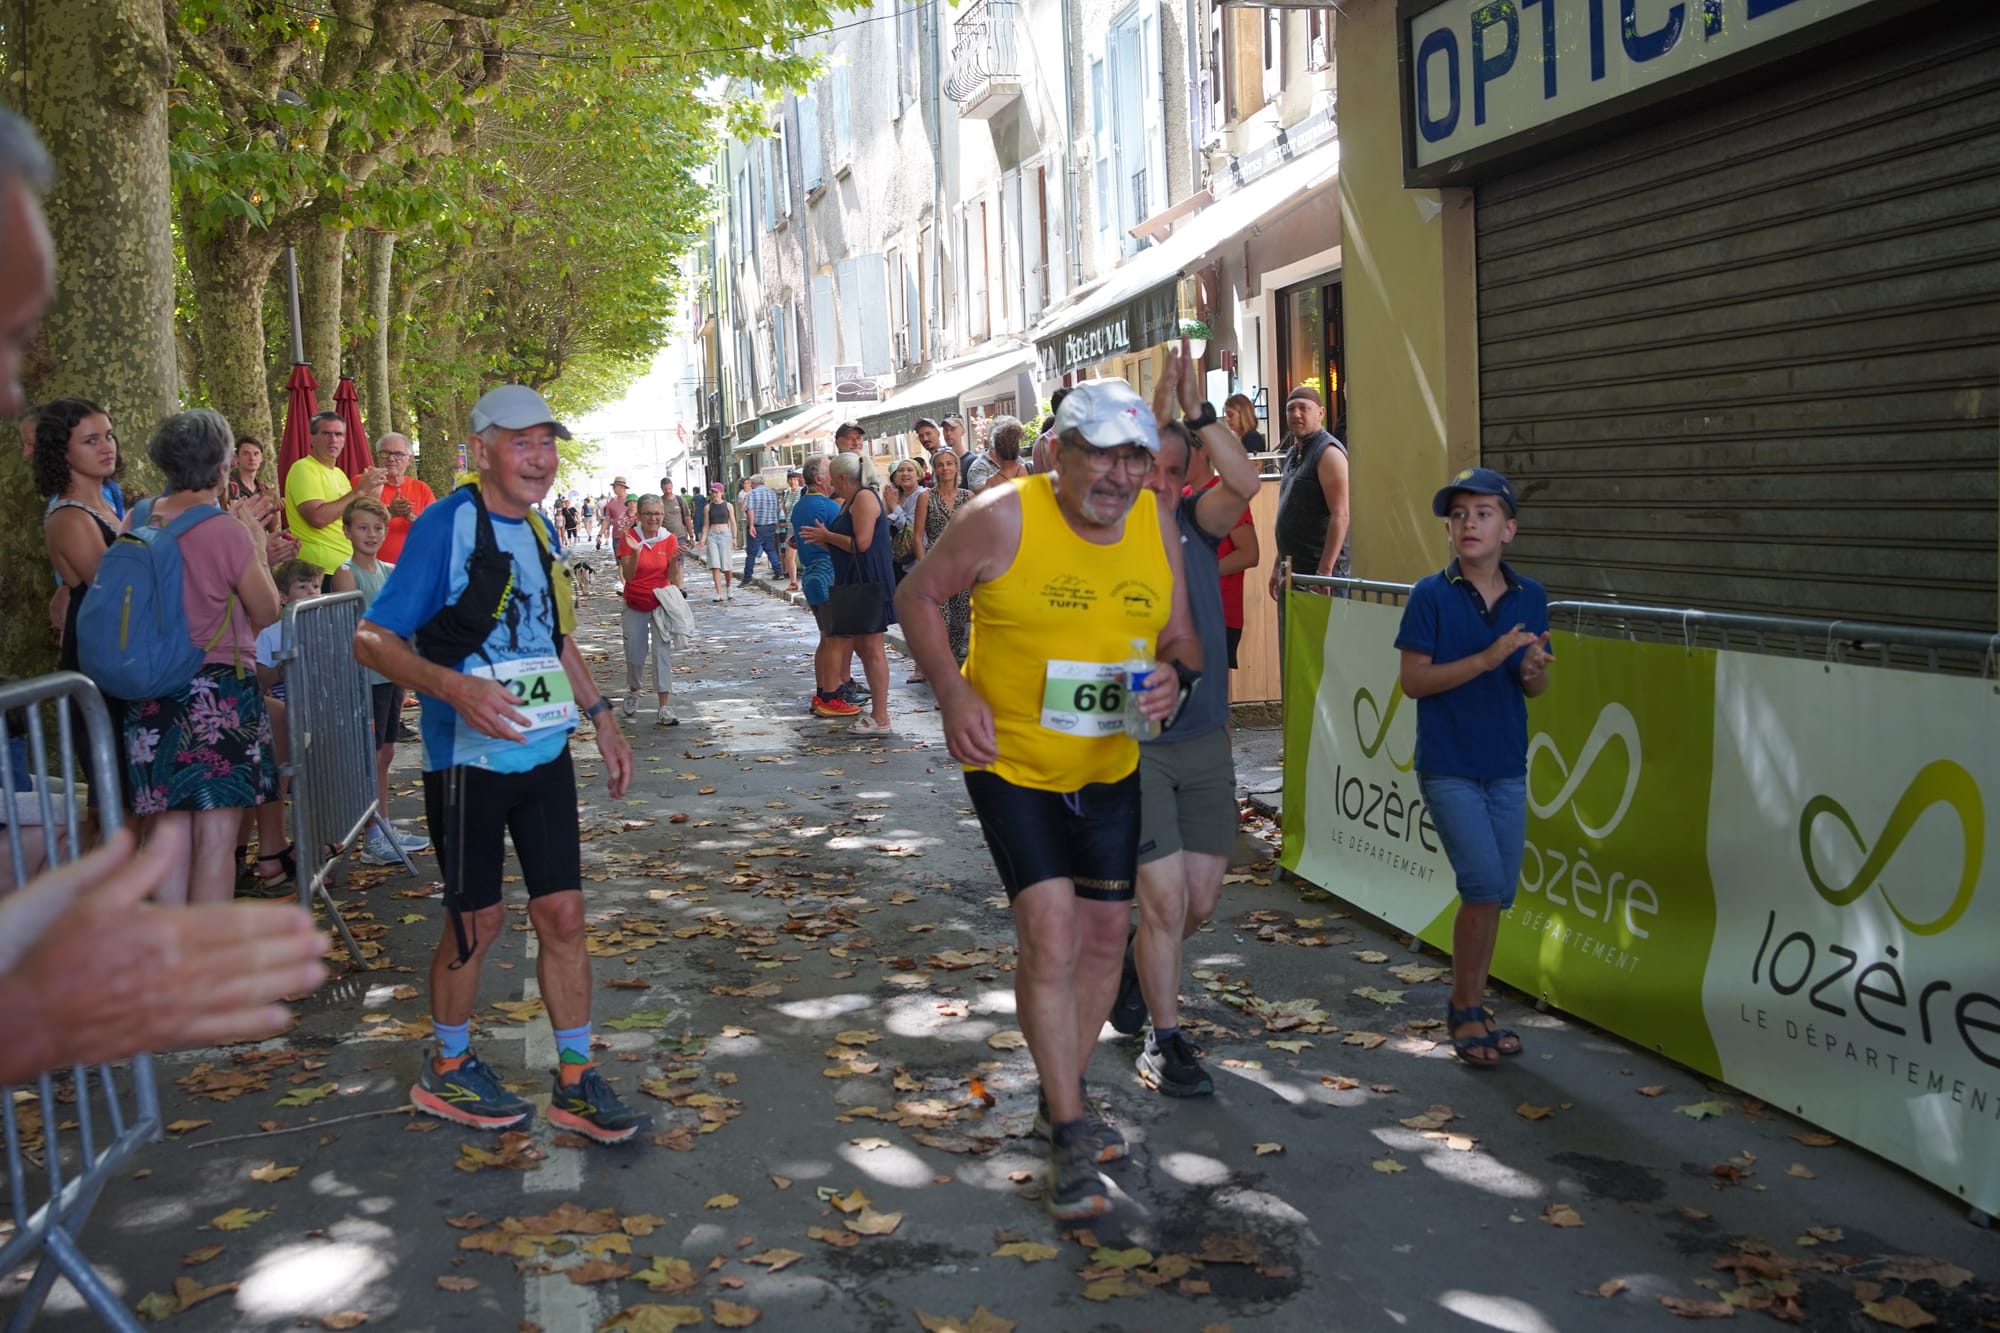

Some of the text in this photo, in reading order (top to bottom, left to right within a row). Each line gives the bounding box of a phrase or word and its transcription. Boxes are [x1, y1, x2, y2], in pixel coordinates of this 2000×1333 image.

[1090, 328, 1105, 357] DU
[1105, 319, 1130, 351] VAL
[1073, 684, 1122, 712] 66
[1335, 764, 1437, 853] lozère
[1332, 829, 1435, 882] LE DÉPARTEMENT
[1520, 840, 1659, 939] ozère
[1522, 911, 1640, 973] DÉPARTEMENT
[1741, 1003, 1768, 1030] LE
[1752, 909, 2000, 1069] lozère
